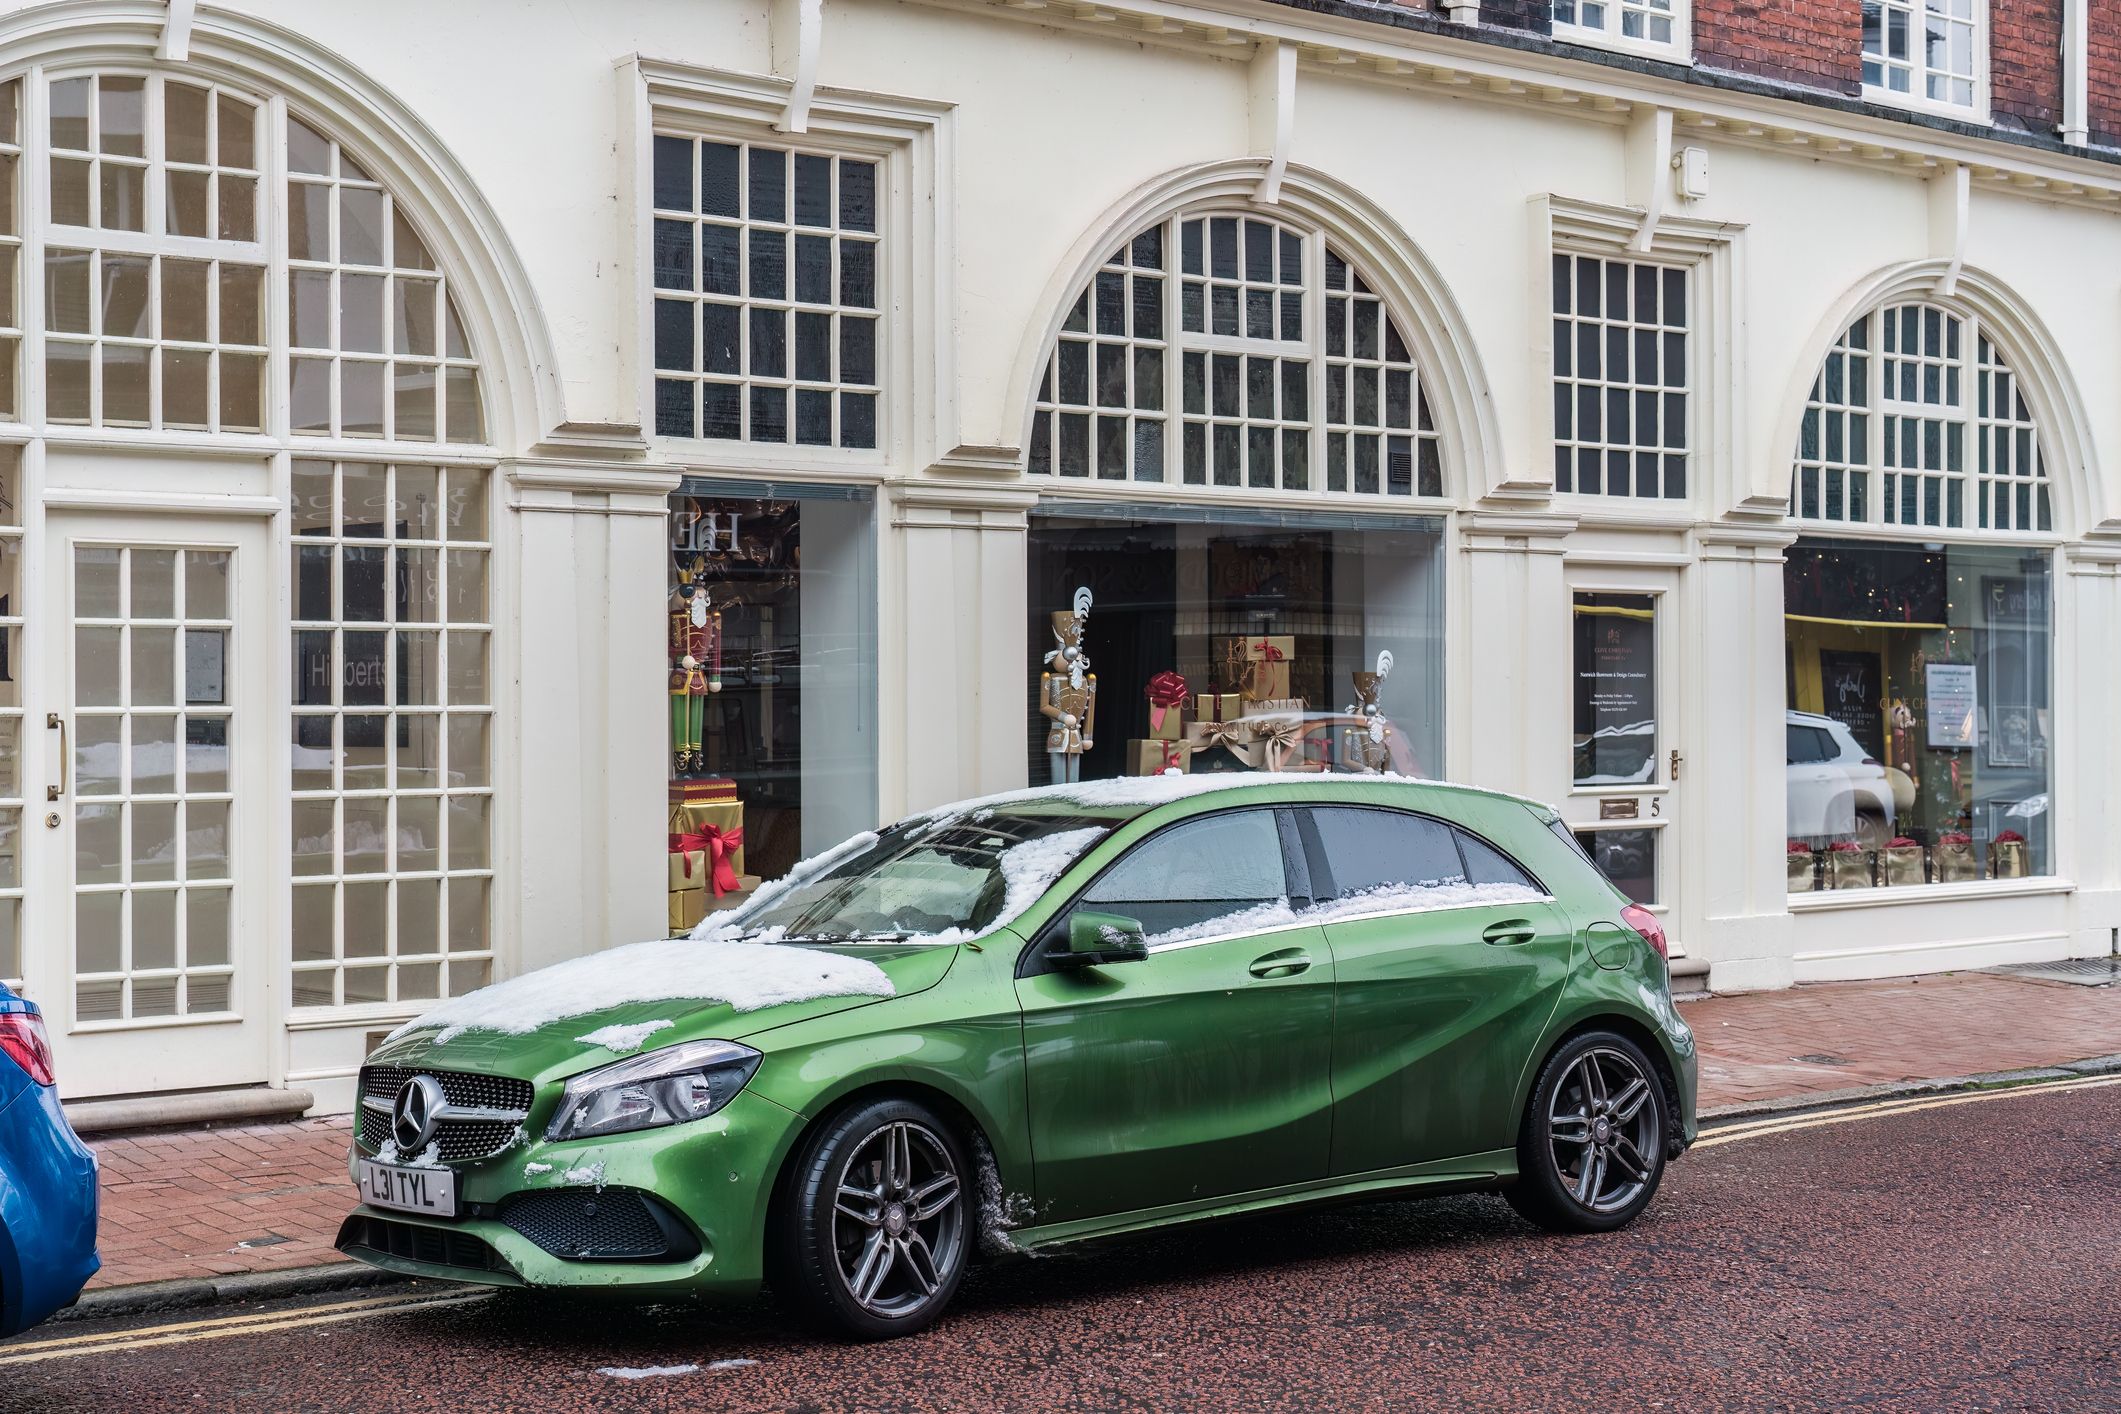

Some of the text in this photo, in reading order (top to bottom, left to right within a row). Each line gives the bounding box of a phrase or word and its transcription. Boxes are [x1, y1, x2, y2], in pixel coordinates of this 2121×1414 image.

[312, 653, 386, 687] Hibert
[1180, 695, 1311, 710] CLE HRISTIAN
[1651, 796, 1661, 818] 5
[370, 1166, 434, 1207] L31 TYL
